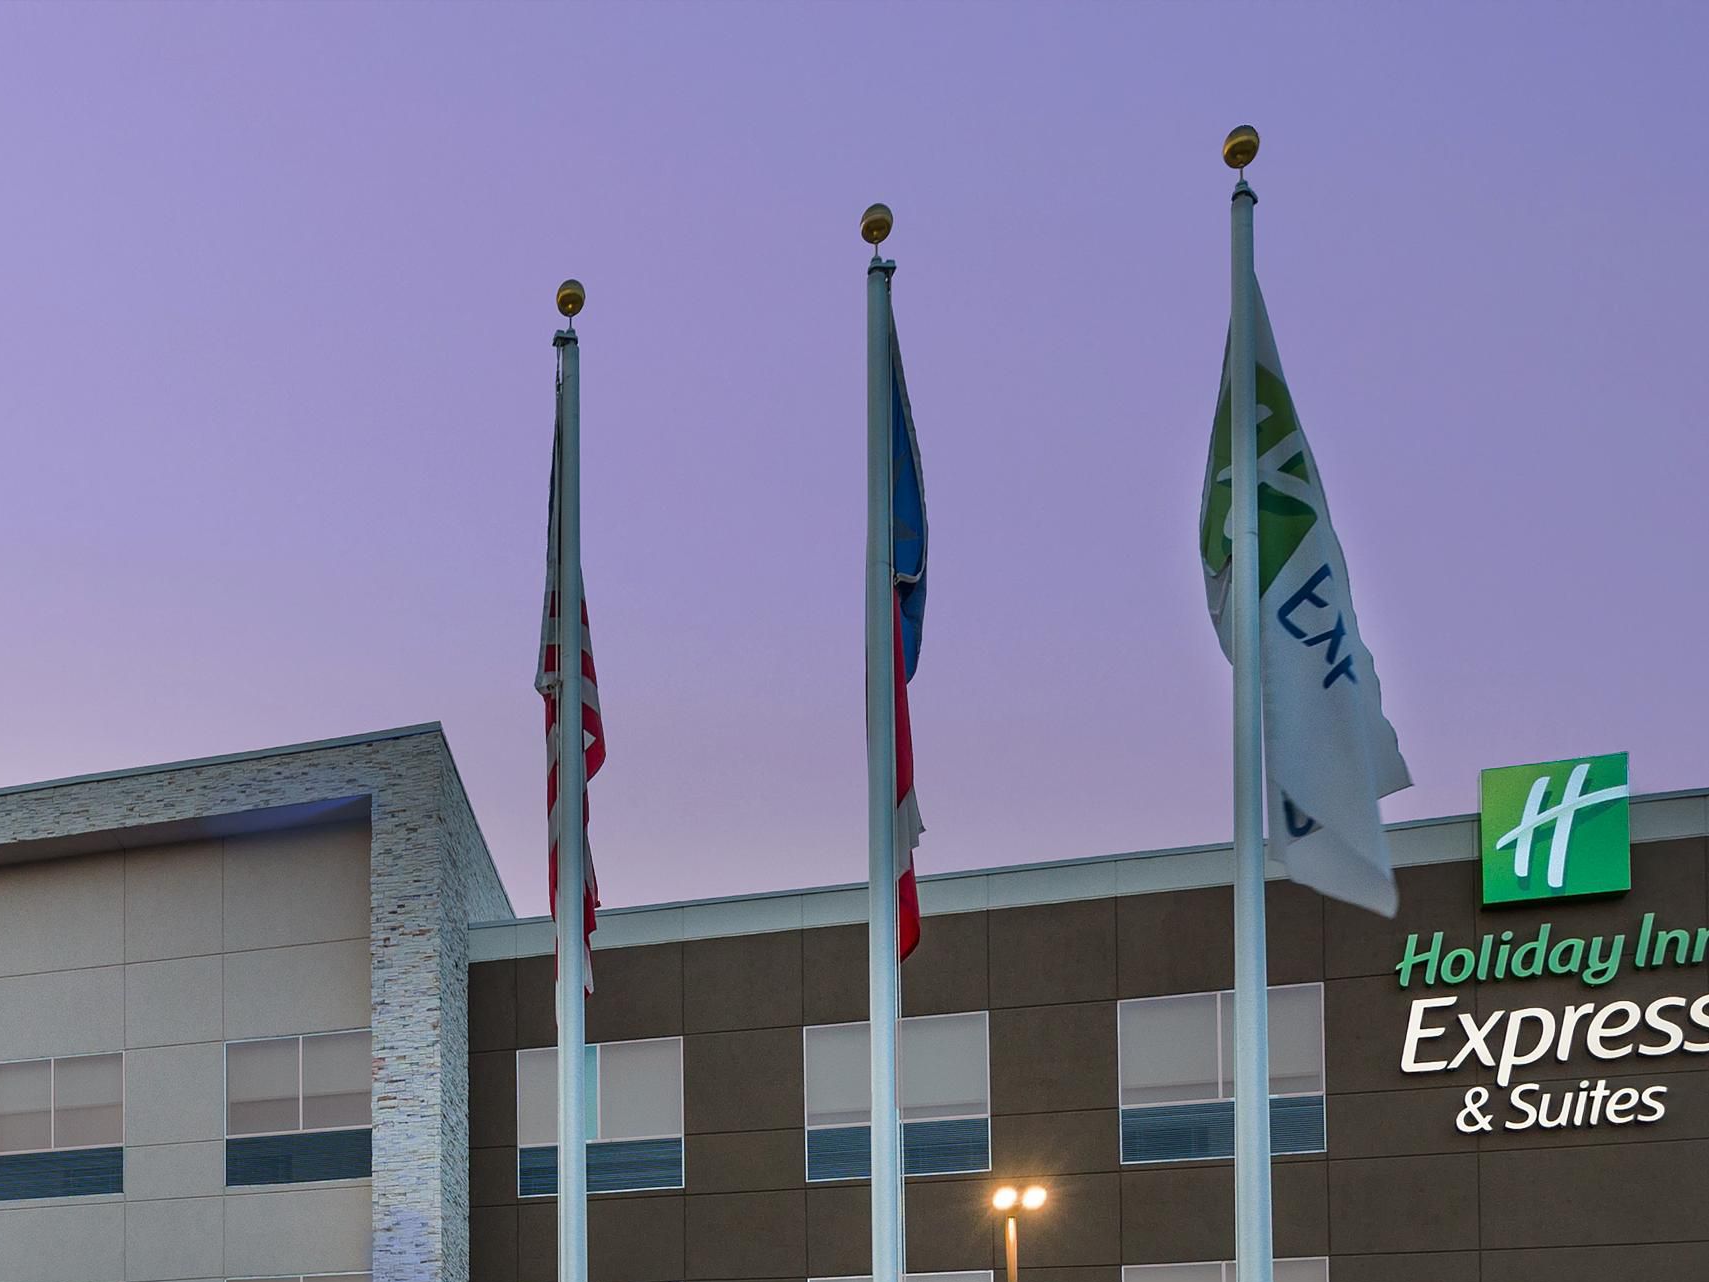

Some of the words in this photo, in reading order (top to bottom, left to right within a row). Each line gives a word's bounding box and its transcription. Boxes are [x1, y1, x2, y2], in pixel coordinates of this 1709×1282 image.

[1395, 923, 1626, 987] Holiday
[1455, 1086, 1494, 1133] &
[1504, 1079, 1668, 1130] Suites
